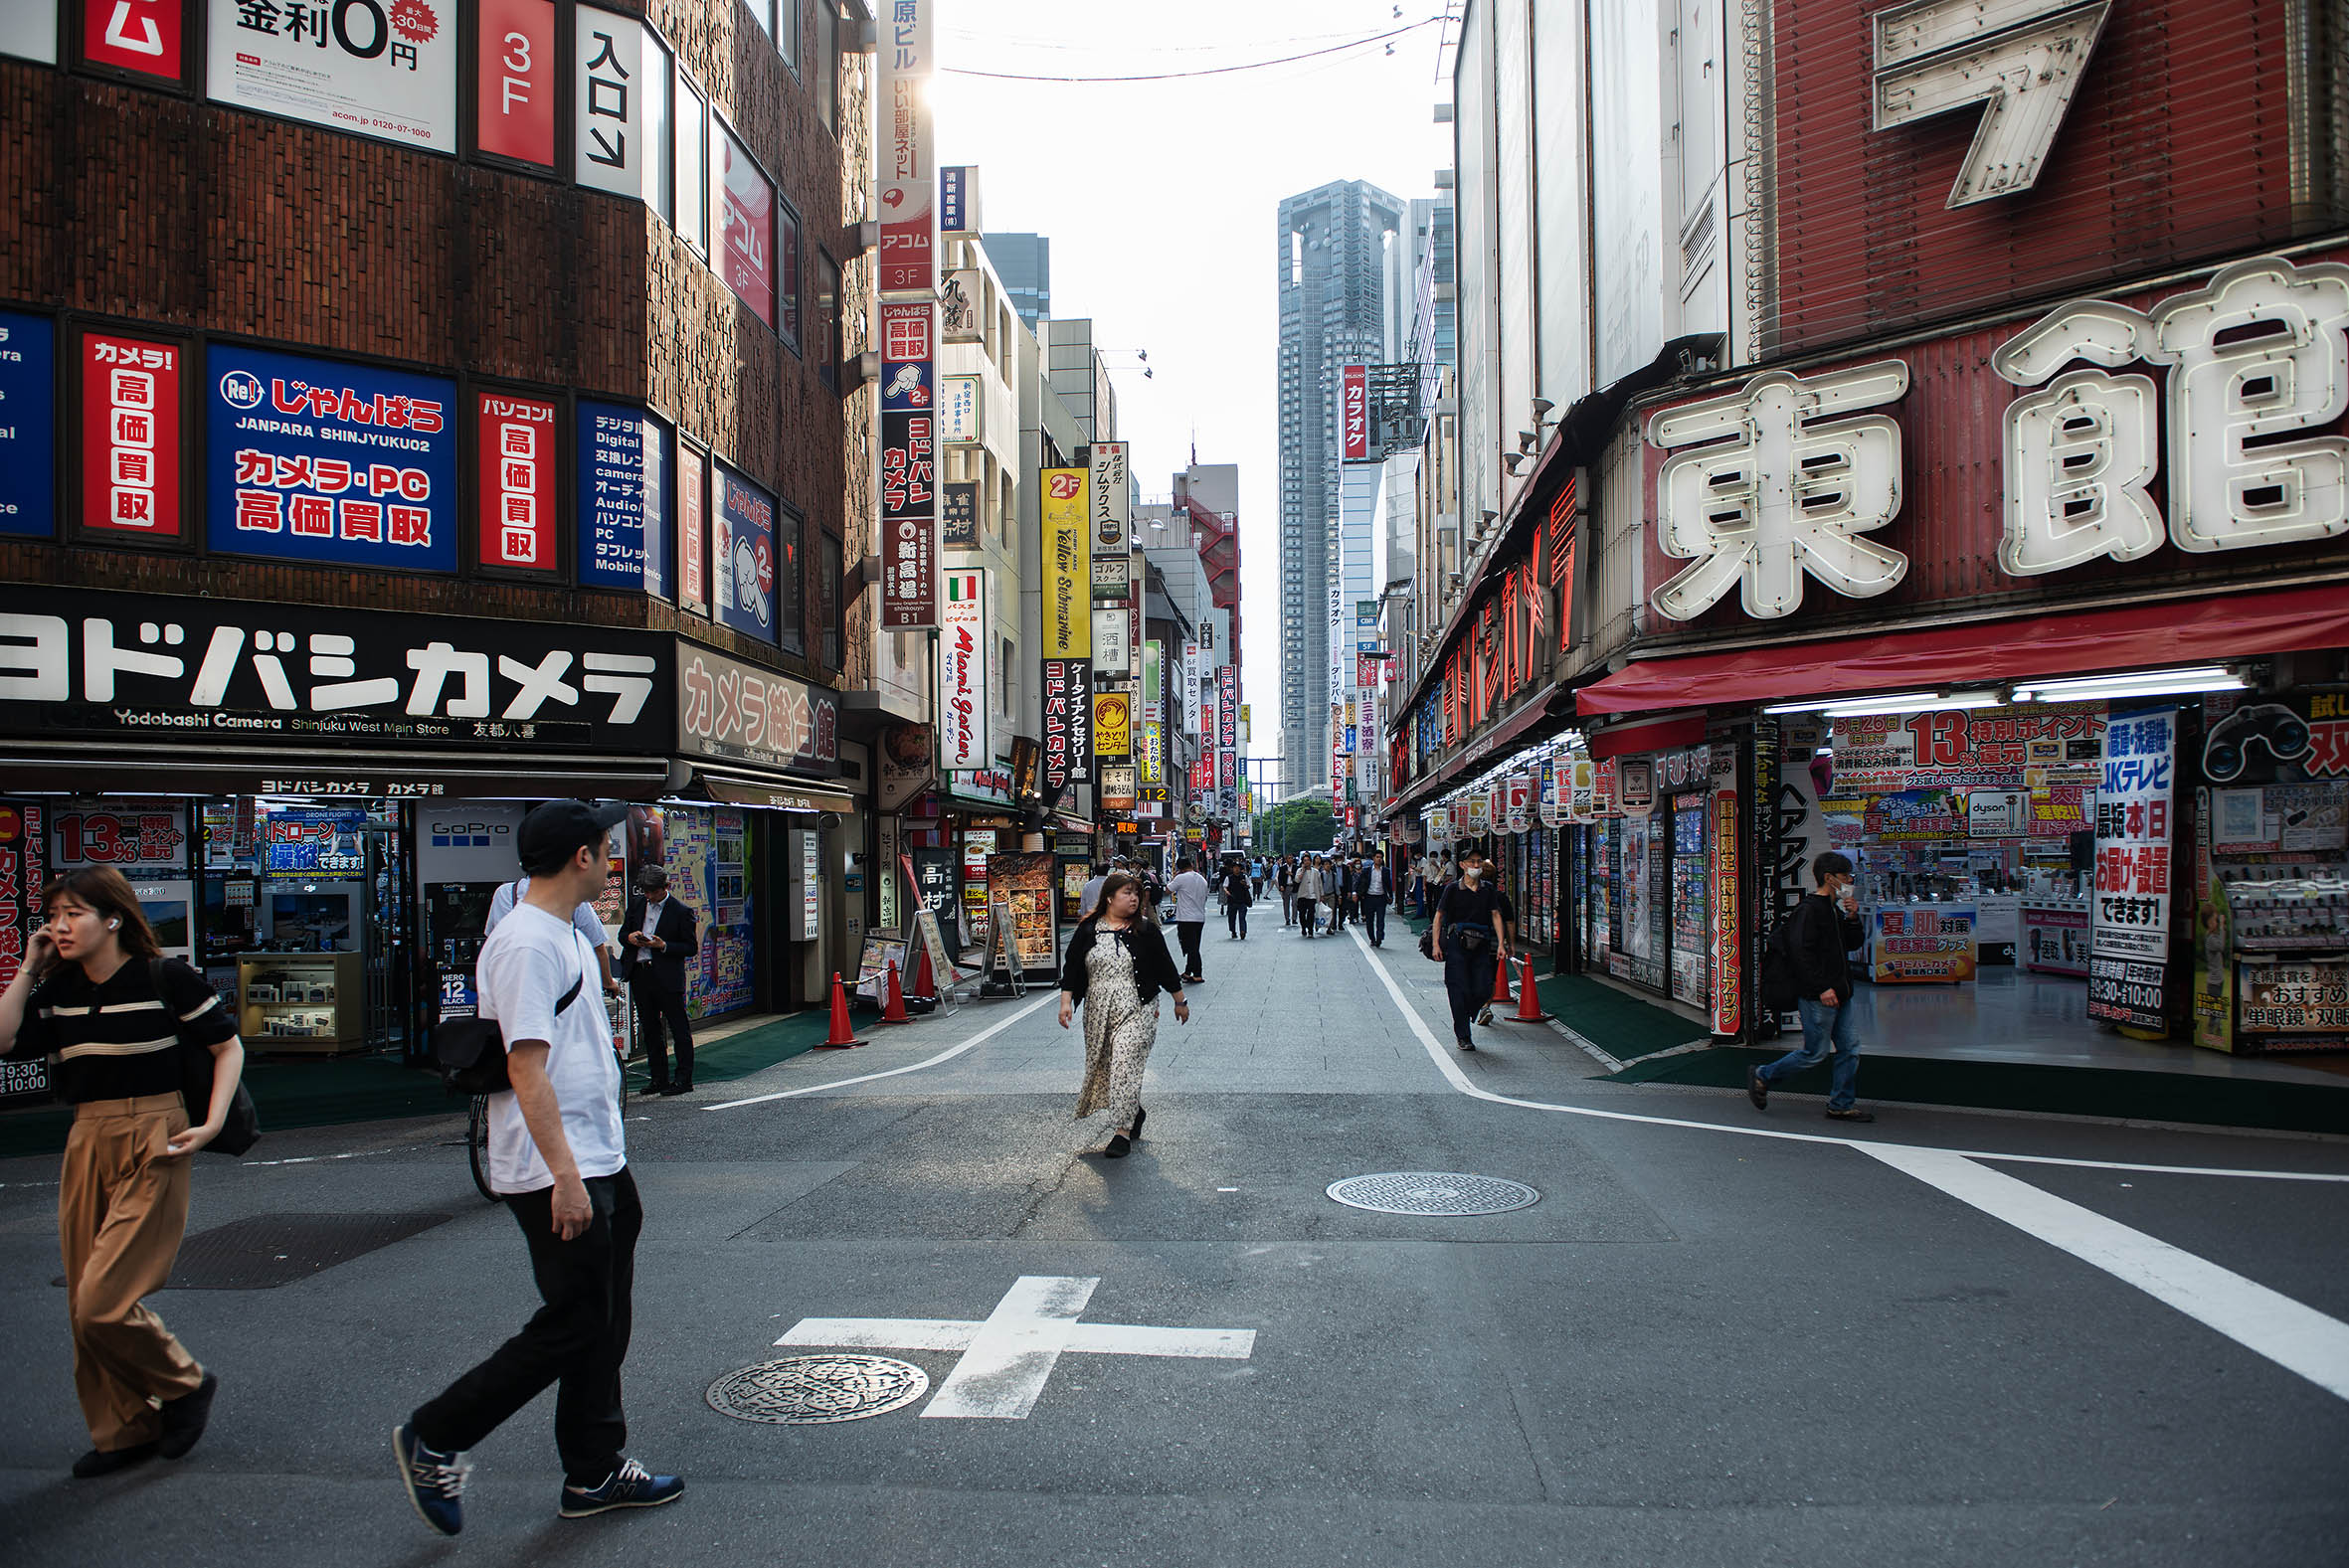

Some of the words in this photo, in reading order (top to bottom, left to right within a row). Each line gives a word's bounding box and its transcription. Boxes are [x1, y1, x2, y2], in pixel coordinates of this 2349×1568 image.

[397, 13, 431, 34] 30日間
[587, 31, 630, 121] 入口
[332, 110, 369, 125] acom.jp
[373, 118, 431, 139] 0120-07-1000
[894, 80, 910, 180] いい部屋ネット
[882, 234, 929, 249] アコム
[735, 264, 749, 293] 3F
[894, 269, 918, 285] 3F
[891, 321, 924, 338] 高価
[94, 343, 173, 371] カメラ!
[891, 339, 924, 358] 買取
[228, 379, 256, 402] Re!
[911, 390, 928, 403] 2F
[962, 382, 971, 414] 新宿西口
[483, 399, 554, 423] パソコン!
[1347, 385, 1364, 447] カラオケ
[111, 369, 154, 526] 高価買取
[236, 417, 313, 437] JANPARA
[320, 428, 431, 452] SHINJYUKU02
[596, 432, 639, 448] Digital
[1648, 257, 2349, 621] 東館
[909, 418, 933, 504] ヨドバシ
[235, 448, 431, 501] カメラ・PC
[596, 467, 644, 482] camera
[882, 447, 907, 511] カメラ
[1051, 474, 1079, 497] 2F
[500, 423, 536, 563] 高価買取
[1096, 460, 1111, 518] シムックス
[235, 488, 432, 547] 高価買取
[596, 511, 644, 528] パソコン
[596, 527, 614, 539] PC
[596, 542, 650, 560] タブレット
[1057, 529, 1071, 574] Yellow
[596, 558, 641, 574] Mobile
[758, 545, 772, 584] 2F
[1094, 564, 1125, 574] ゴルフ
[901, 612, 918, 623] B1
[1056, 576, 1071, 650] Submarine
[1329, 590, 1339, 627] カラオケ
[0, 612, 655, 725] ヨドバシカメラ
[686, 656, 836, 763] カメラ総合館
[1221, 666, 1234, 746] ヨドバシカメラ
[114, 709, 209, 727] Yodobashi
[213, 713, 282, 729] Camera
[291, 718, 346, 733] Shinjuku
[350, 721, 381, 733] West
[384, 724, 413, 734] Main
[417, 724, 450, 735] Store
[473, 723, 537, 739] 友都八喜
[1047, 661, 1065, 788] ヨドバシカメラ
[1070, 662, 1087, 780] ケータイアクセサリー館
[1834, 714, 1900, 735] 5月26日
[1970, 716, 2107, 742] 特別ポイント
[1096, 731, 1126, 741] やきとり
[1096, 743, 1128, 752] センター
[1907, 710, 1976, 767] 13%
[1149, 738, 1161, 781] おたからや
[1835, 757, 1900, 770] 消費税込み特価
[1978, 742, 2027, 765] 還元
[262, 781, 370, 793] ヨドバシカメラ
[388, 783, 444, 795] カメラ館
[1972, 802, 2006, 815] dyson
[140, 816, 171, 829] 特別
[270, 821, 336, 842] ドローン
[432, 822, 510, 835] GoPro
[1117, 821, 1138, 833] 買取
[1719, 798, 1735, 872] 期間限定
[55, 814, 136, 862] 13%
[140, 829, 185, 844] ポイント
[23, 806, 44, 914] ヨドバシカメラ
[269, 842, 319, 870] 操縦
[318, 854, 365, 870] できます!
[2095, 846, 2170, 894] お届け・設置
[921, 862, 945, 910] 高村
[1882, 909, 1970, 936] 夏の肌対策
[2100, 897, 2159, 925] できます!
[1718, 875, 1737, 1023] 特別ポイントアップ
[1886, 937, 1969, 953] 美容家電グッズ
[442, 973, 465, 982] HERO
[2090, 958, 2126, 980] 営業時間
[2129, 964, 2161, 983] 年中無休
[442, 981, 465, 998] 12
[2127, 983, 2162, 1009] 10:00
[7, 1077, 46, 1092] 10:00
